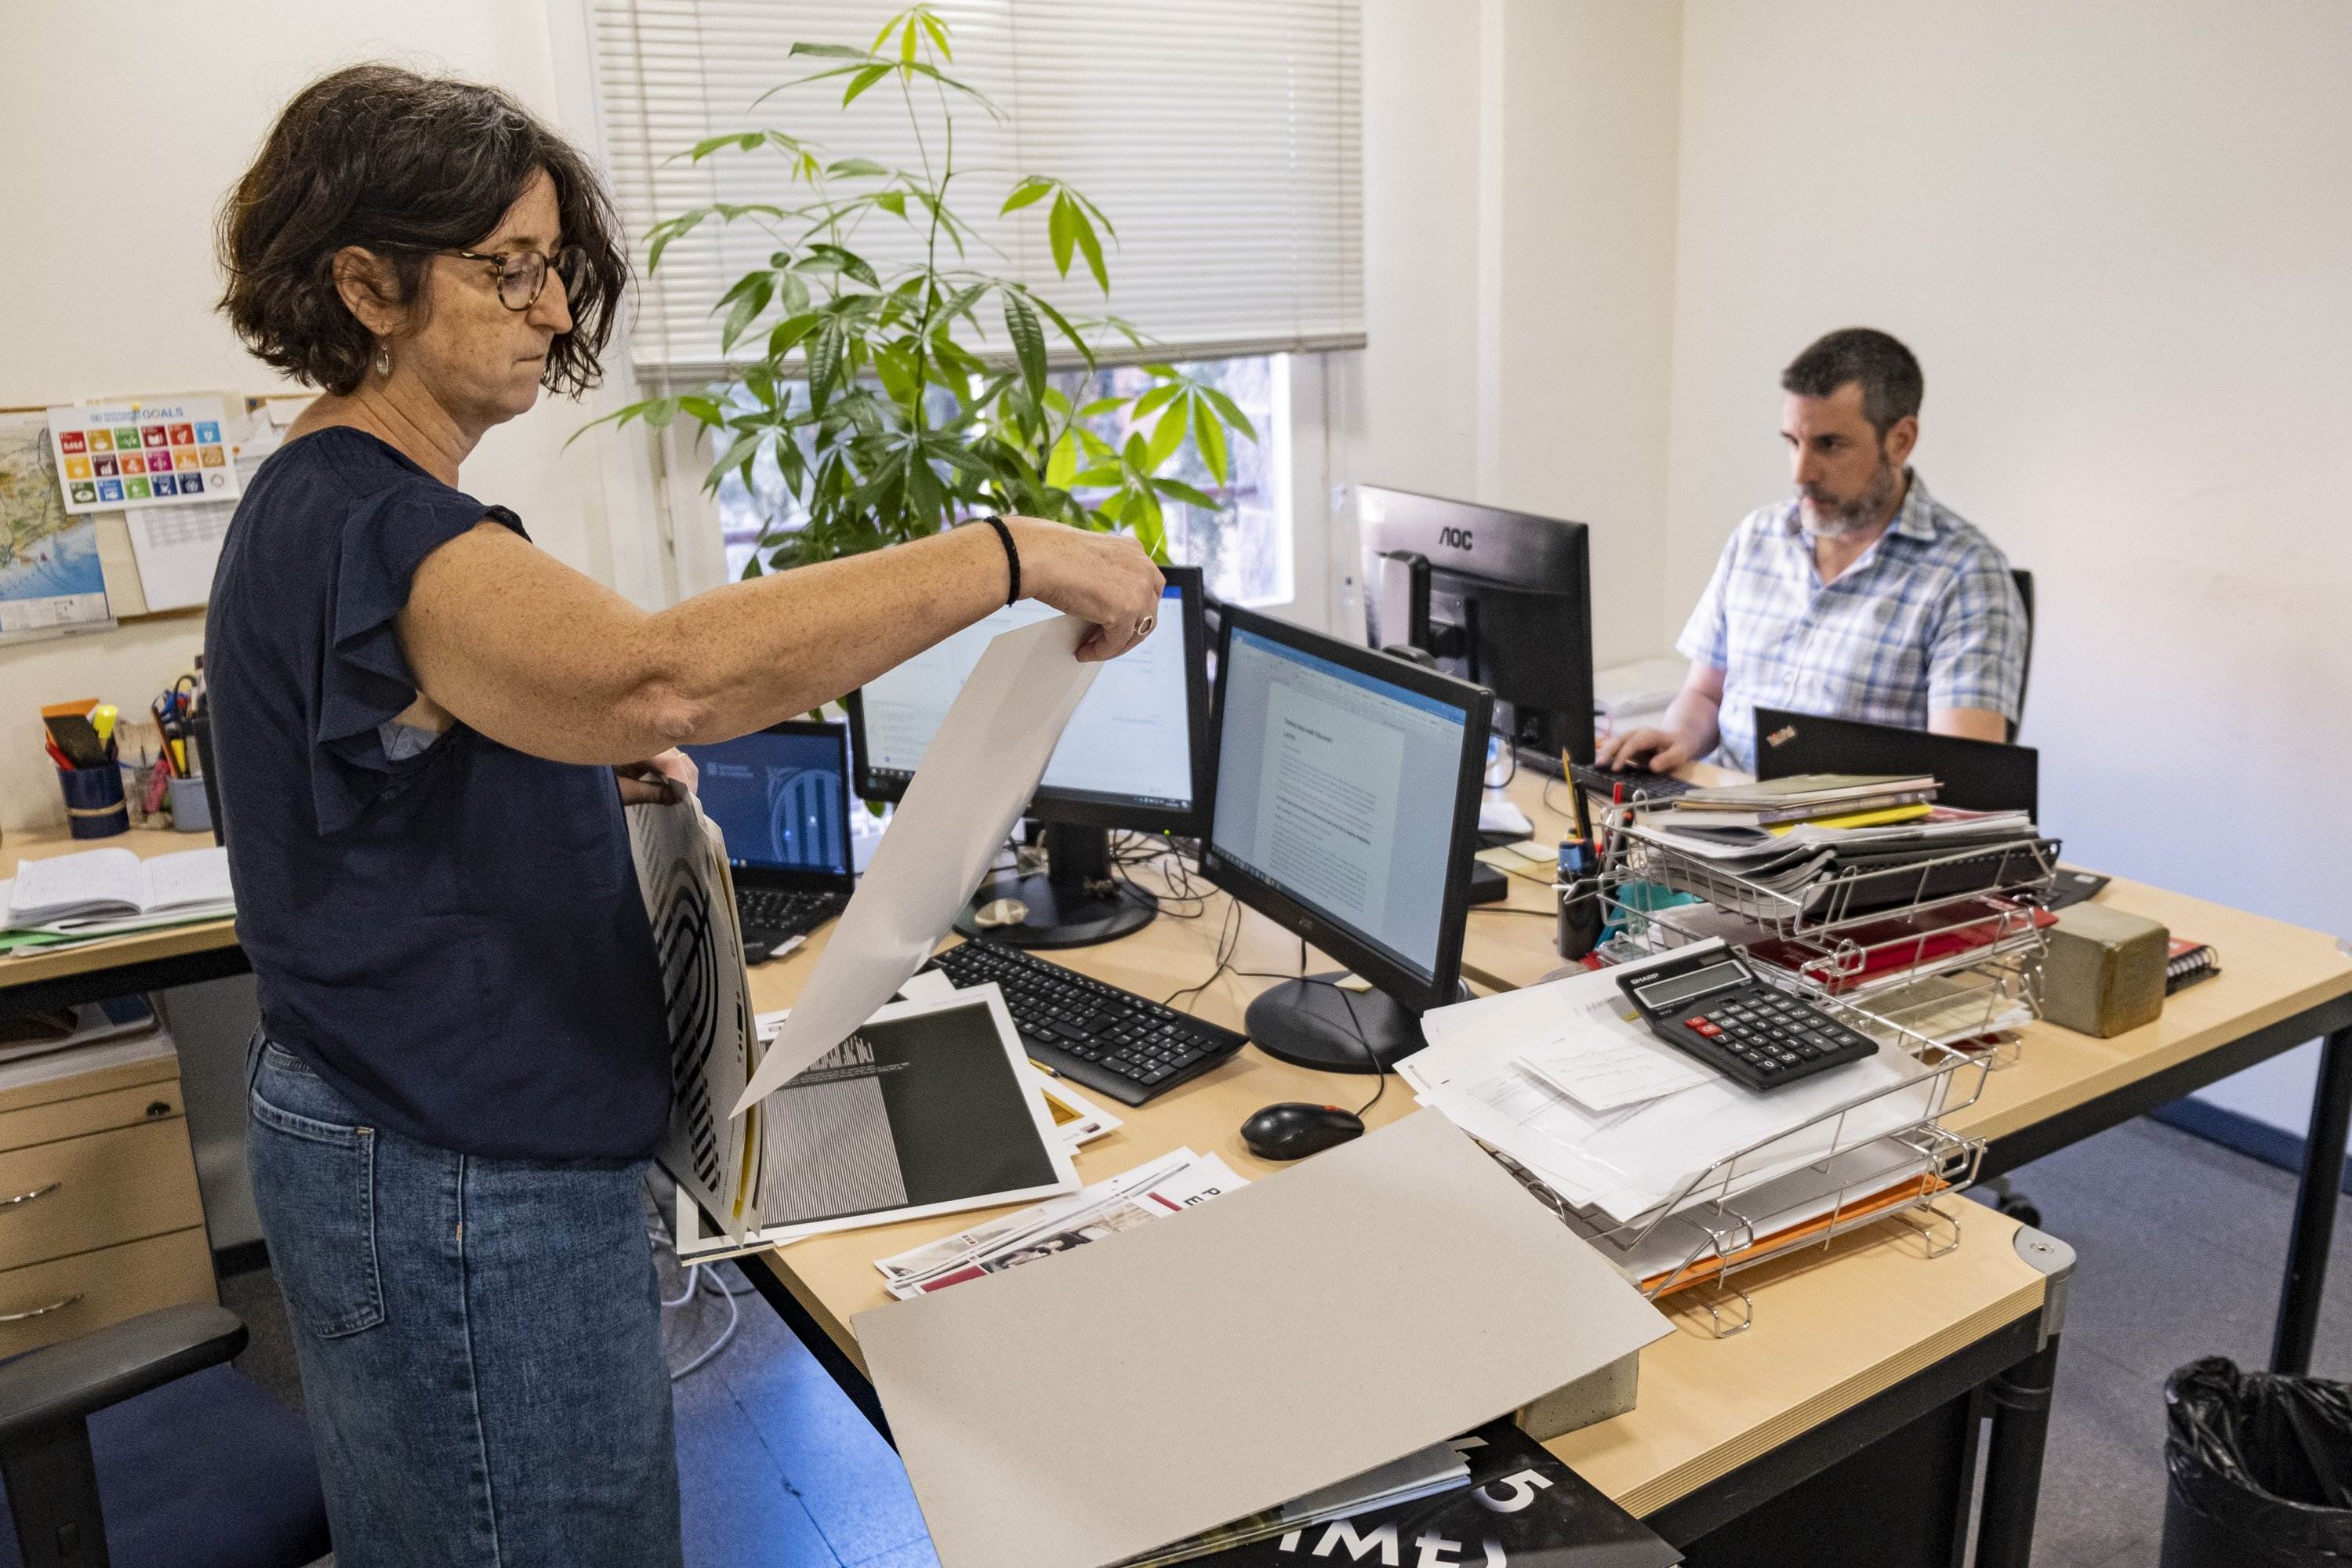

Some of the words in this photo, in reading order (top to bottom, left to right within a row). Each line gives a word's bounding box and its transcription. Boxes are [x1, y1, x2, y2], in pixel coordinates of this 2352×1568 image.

[142, 407, 183, 419] GOALS
[1439, 526, 1472, 550] AOC
[1630, 972, 1659, 985] SHARP
